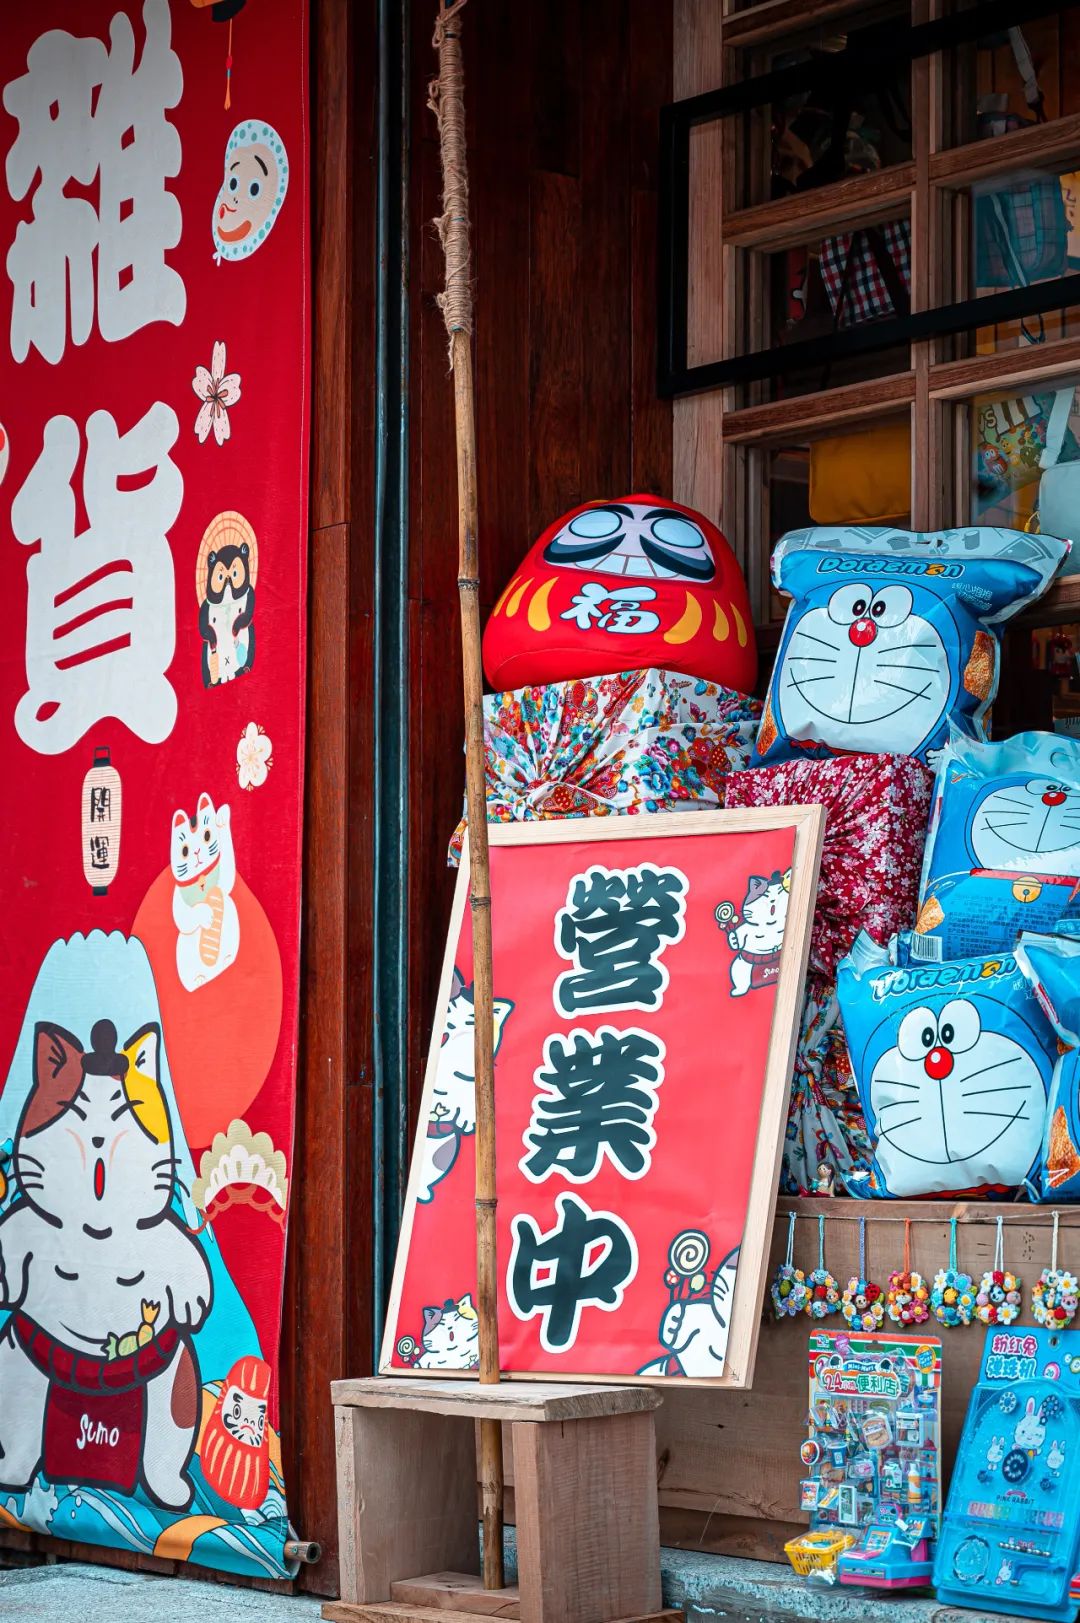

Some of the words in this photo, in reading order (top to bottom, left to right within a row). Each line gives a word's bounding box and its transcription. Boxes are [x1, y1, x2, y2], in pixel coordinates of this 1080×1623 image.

[2, 0, 188, 756] 雜貨
[818, 557, 966, 578] Doraemon
[560, 582, 661, 634] 福
[90, 786, 111, 869] 開運
[508, 863, 689, 1352] 營業中
[987, 1355, 1036, 1379] 弹珠机
[993, 1334, 1036, 1357] 粉红兔
